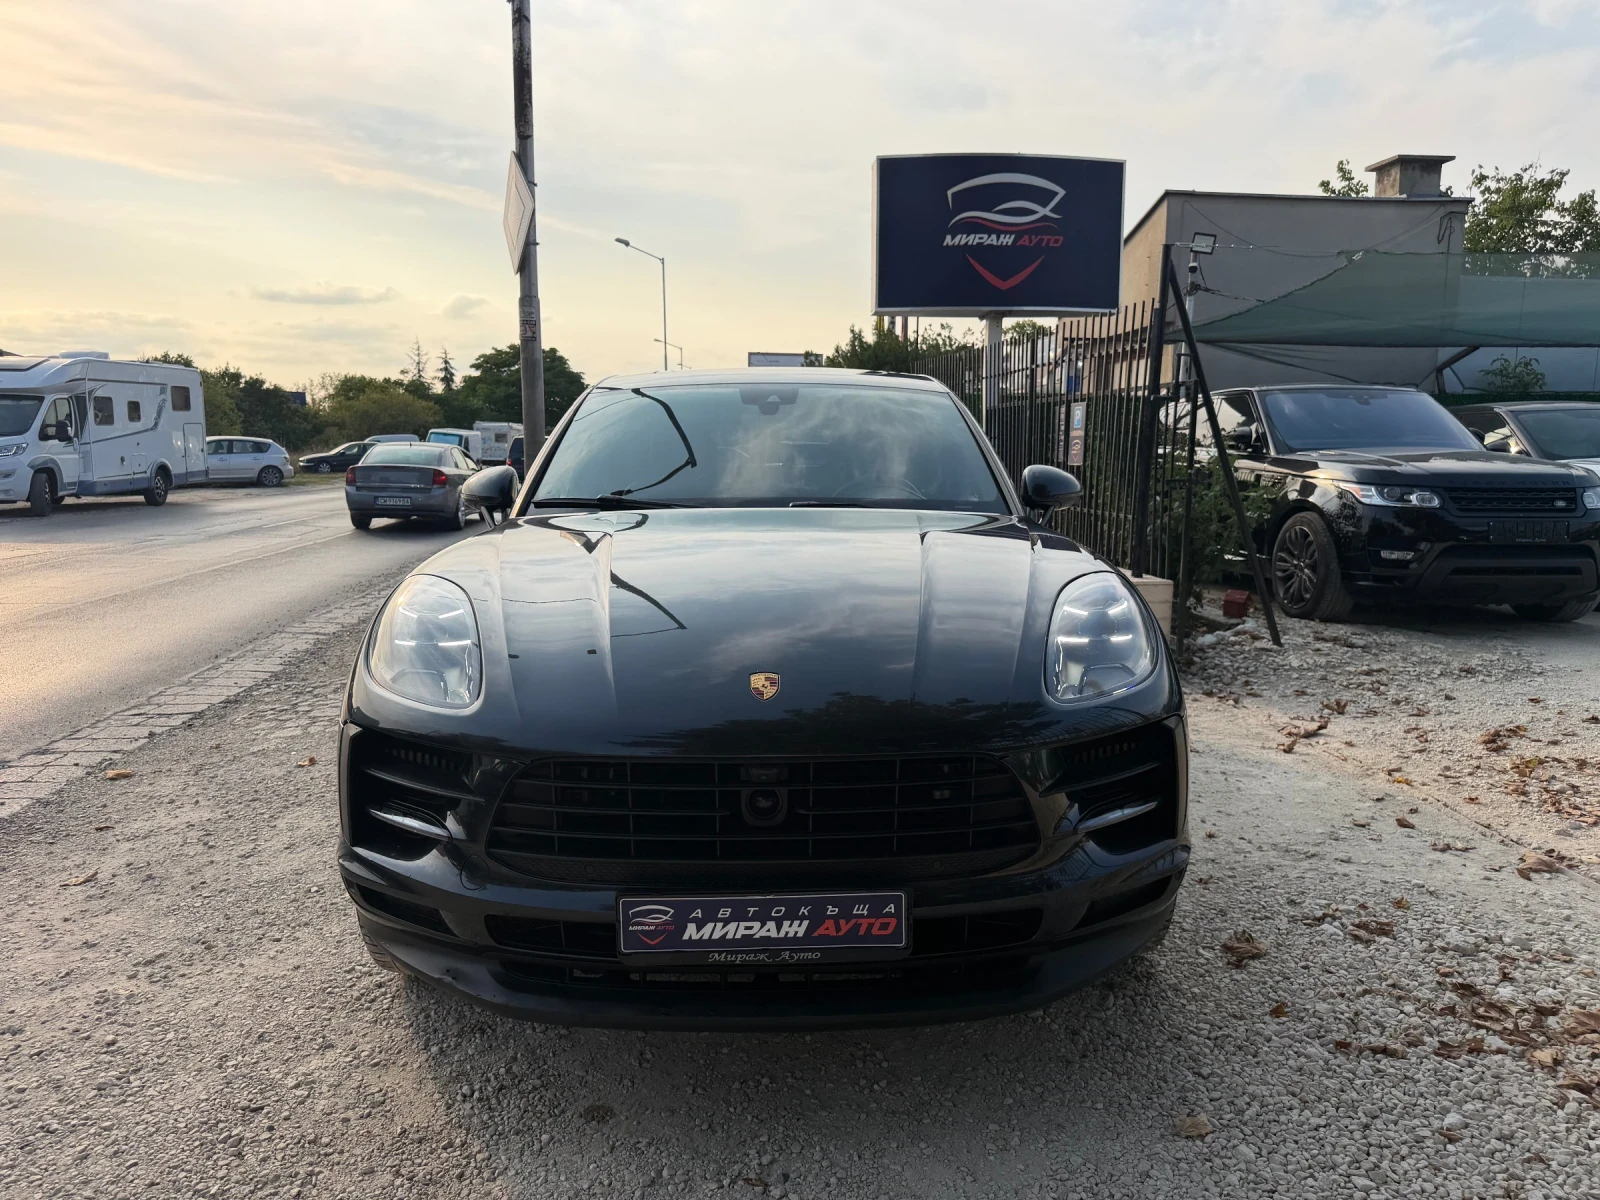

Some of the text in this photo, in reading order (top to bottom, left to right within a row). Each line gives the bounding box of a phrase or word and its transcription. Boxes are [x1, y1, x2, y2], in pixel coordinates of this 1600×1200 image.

[943, 233, 1064, 247] МИРАЖ АУТО
[688, 903, 895, 919] АВТОКЪЩА
[682, 917, 897, 940] МИРАЖ АУТО
[708, 950, 821, 964] Мираж Ауто
